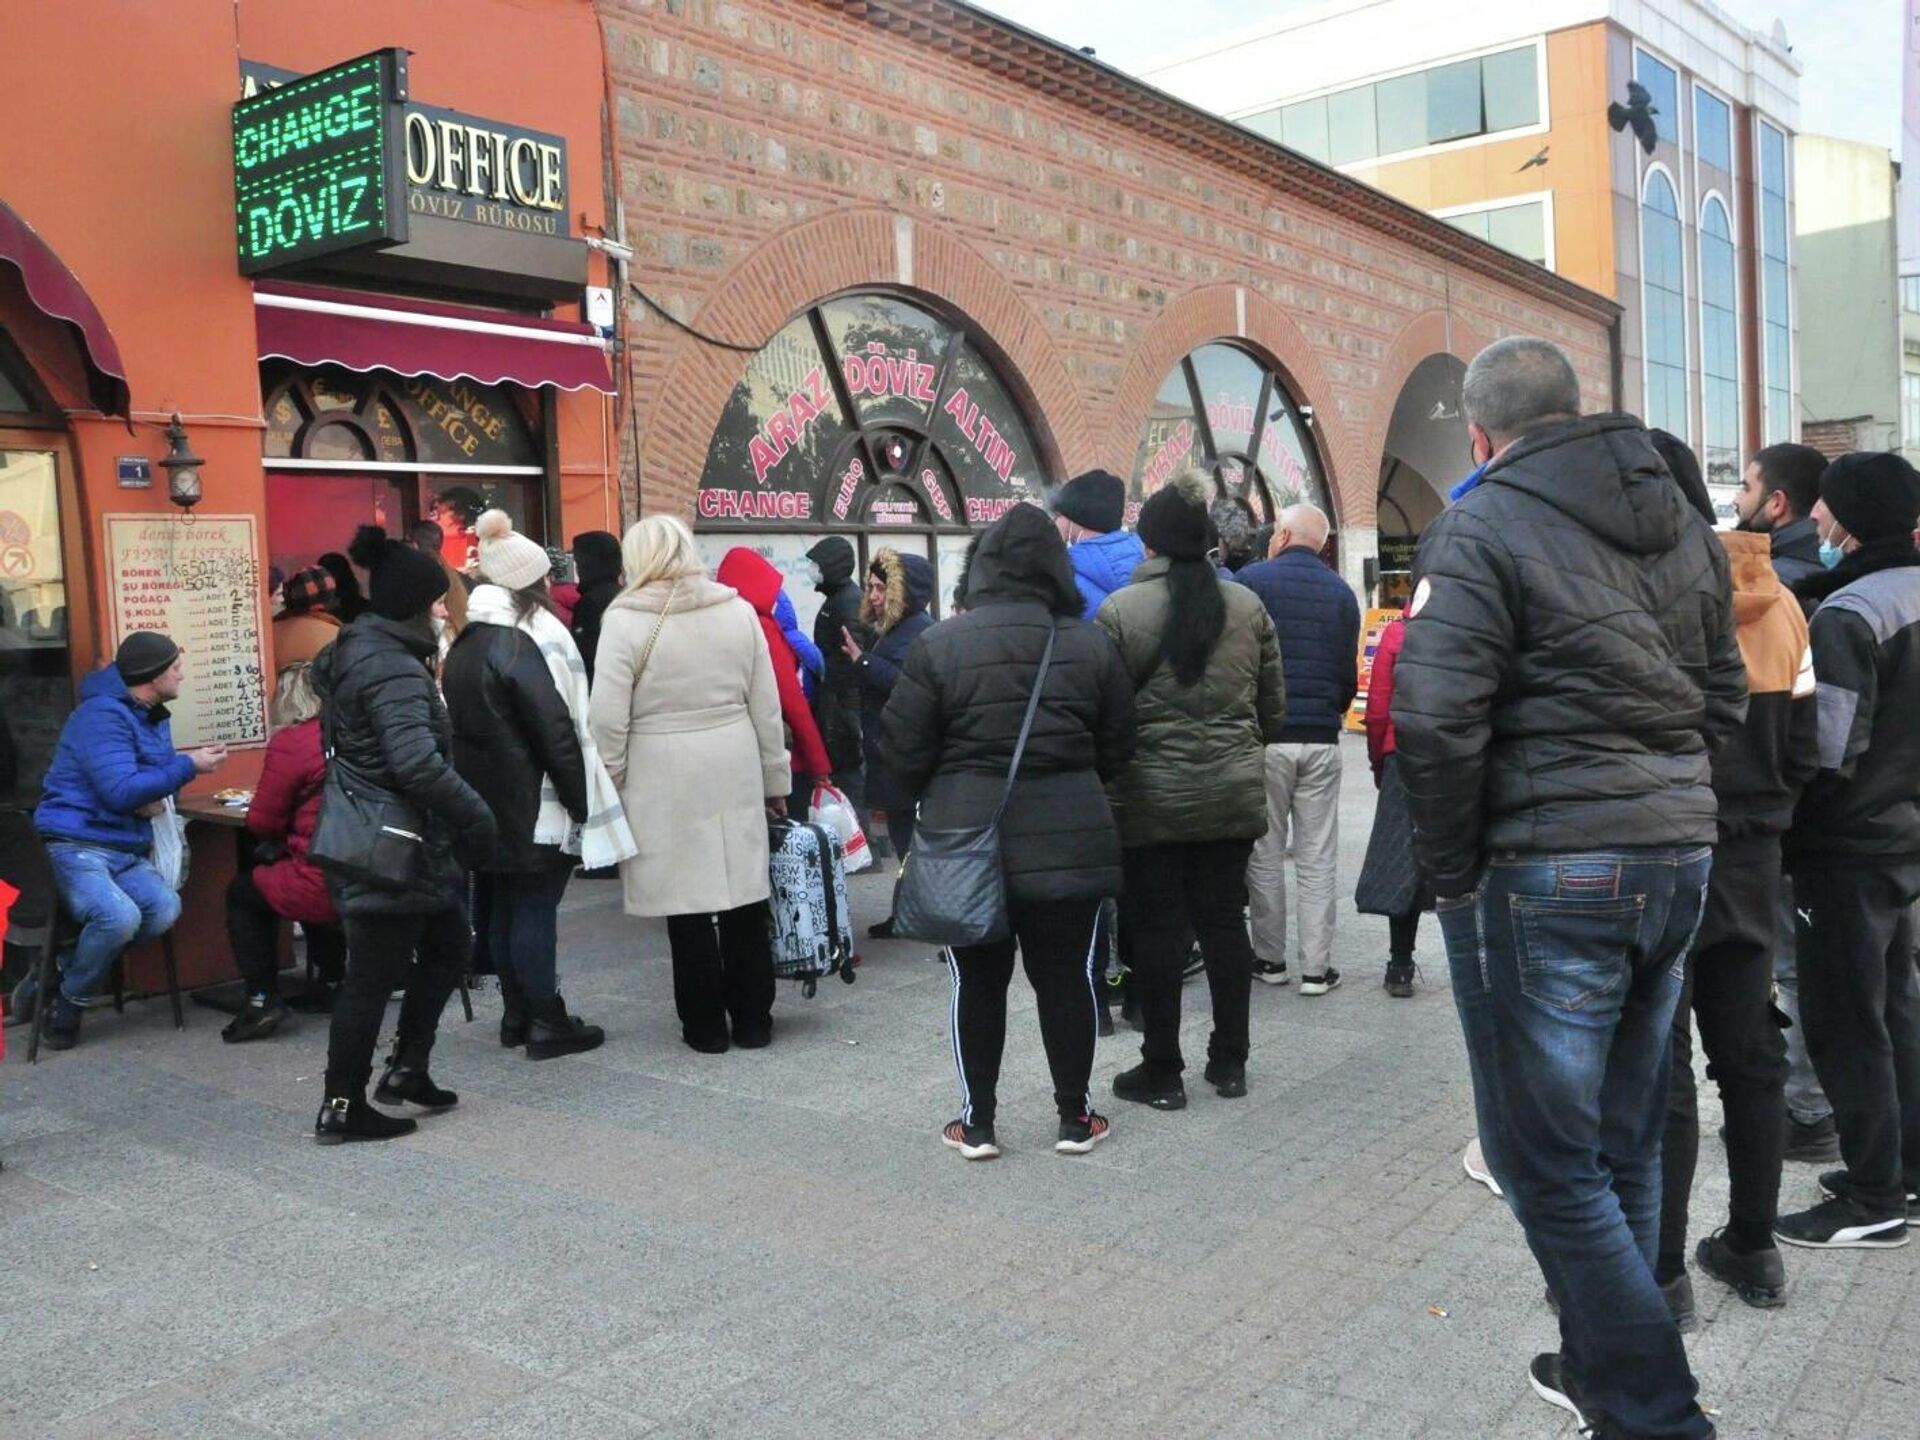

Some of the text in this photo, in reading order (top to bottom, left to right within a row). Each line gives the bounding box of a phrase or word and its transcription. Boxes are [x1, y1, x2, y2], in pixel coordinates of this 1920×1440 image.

[239, 85, 374, 169] CHANGE
[404, 111, 564, 212] OFFICE
[249, 172, 371, 257] DÖVİZ
[410, 188, 558, 235] ÖVİZ BÜROSU
[843, 341, 939, 401] DÖVİZ
[748, 367, 834, 484] ARAZ
[943, 387, 1018, 484] ALTIN
[1142, 418, 1194, 495] ARAZ
[697, 488, 810, 519] CHANGE
[833, 457, 864, 520] EURO
[122, 582, 138, 591] SU
[772, 863, 800, 877] NEW
